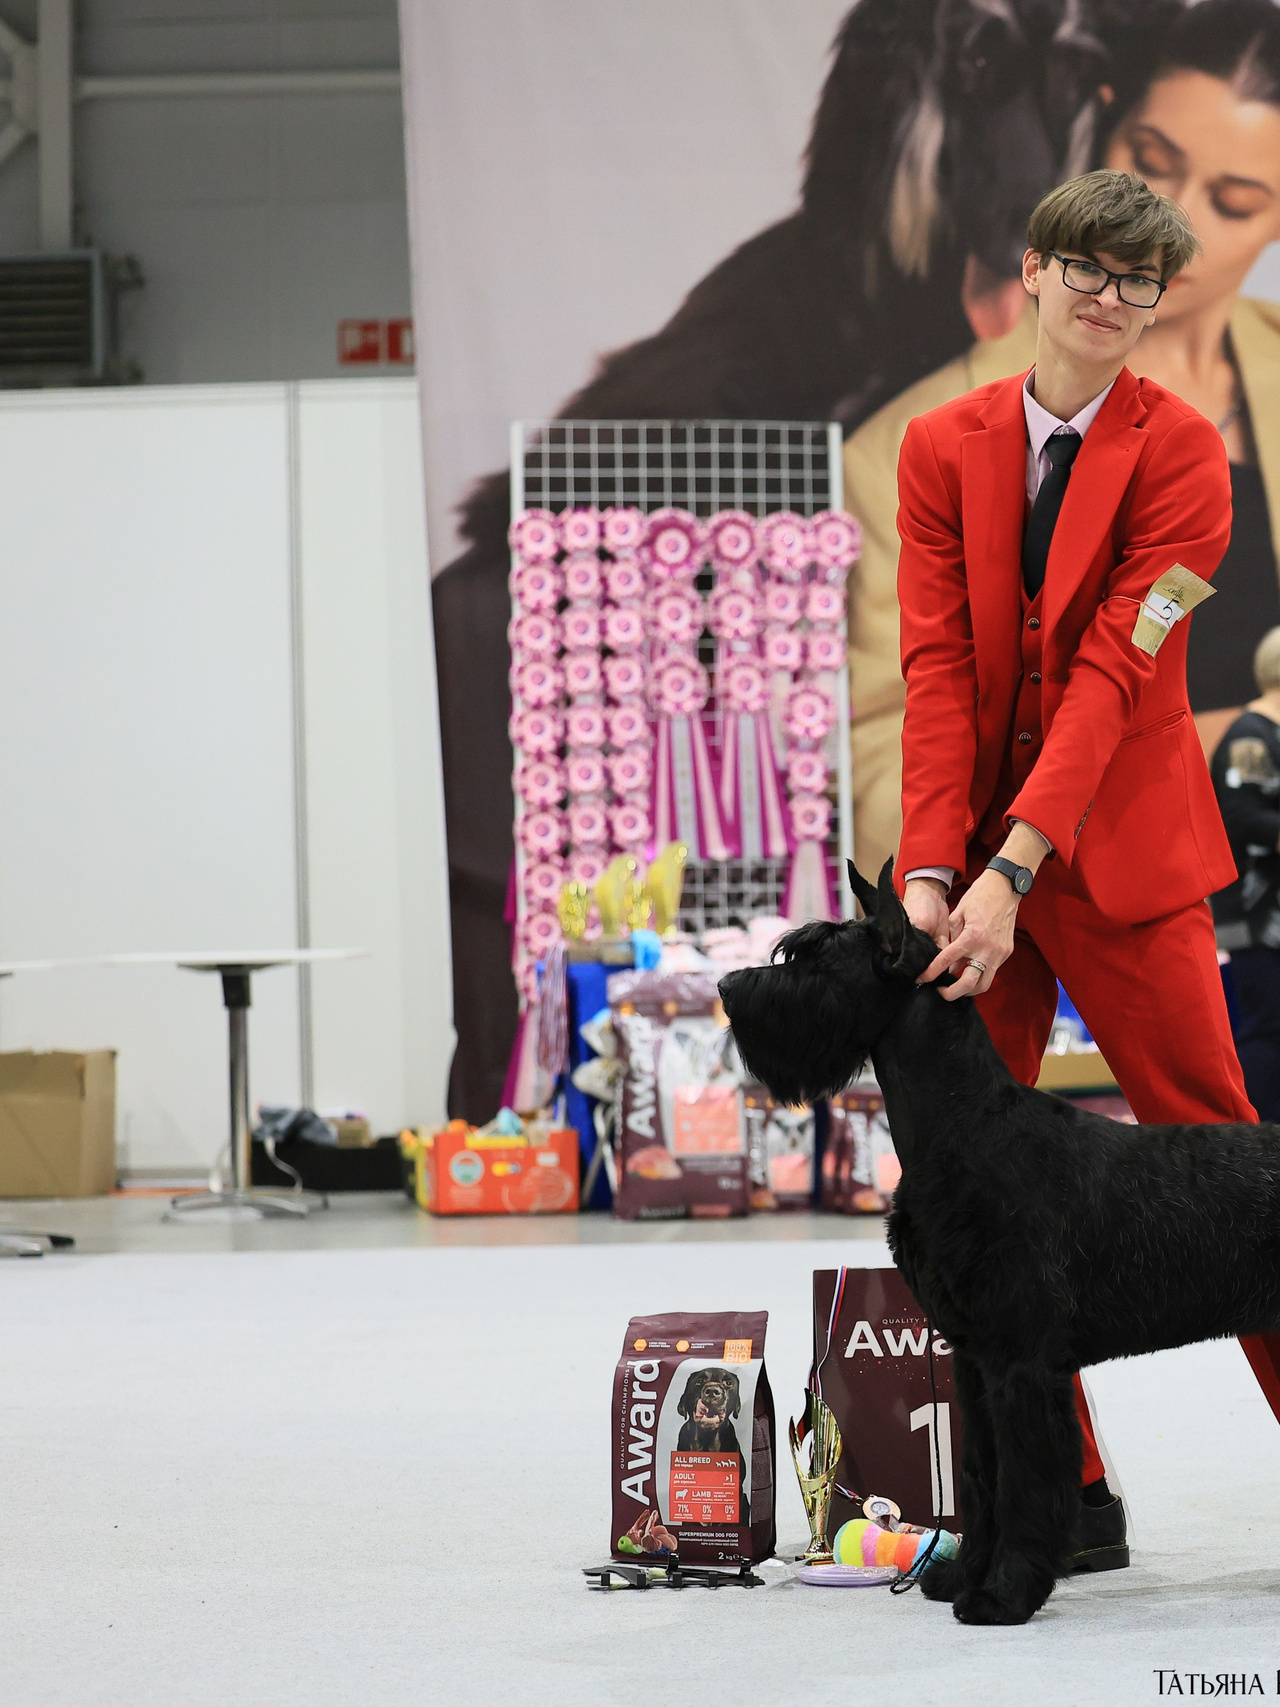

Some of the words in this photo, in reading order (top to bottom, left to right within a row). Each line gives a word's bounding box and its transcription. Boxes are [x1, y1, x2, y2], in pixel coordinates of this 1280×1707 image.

[1160, 598, 1179, 620] 5
[727, 1342, 750, 1352] 100%
[726, 1352, 749, 1363] BIO
[621, 1368, 630, 1414] CHAMPIONS
[621, 1359, 662, 1506] Award
[688, 1456, 711, 1464] BREED
[909, 1402, 956, 1518] 1
[691, 1490, 711, 1498] LAMB
[677, 1504, 689, 1513] 71%
[702, 1504, 712, 1514] 0%
[724, 1505, 735, 1514] 0%
[718, 1552, 724, 1560] 2
